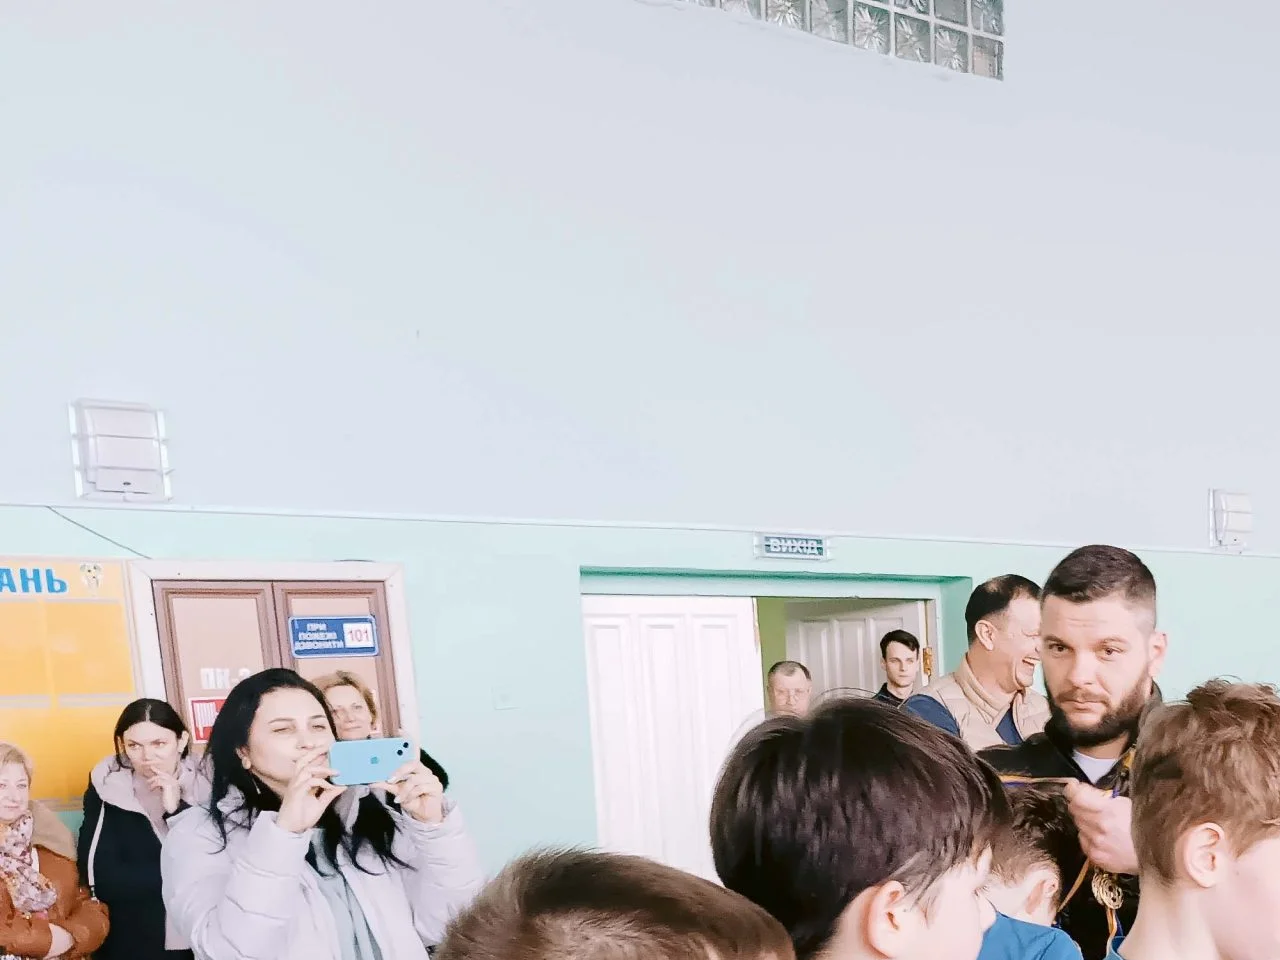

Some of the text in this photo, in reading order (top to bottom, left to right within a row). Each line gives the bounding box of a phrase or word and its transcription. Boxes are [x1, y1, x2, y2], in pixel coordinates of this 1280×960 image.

[770, 538, 819, 555] ВИХІД
[0, 567, 68, 594] АНЬ
[348, 629, 370, 642] 101
